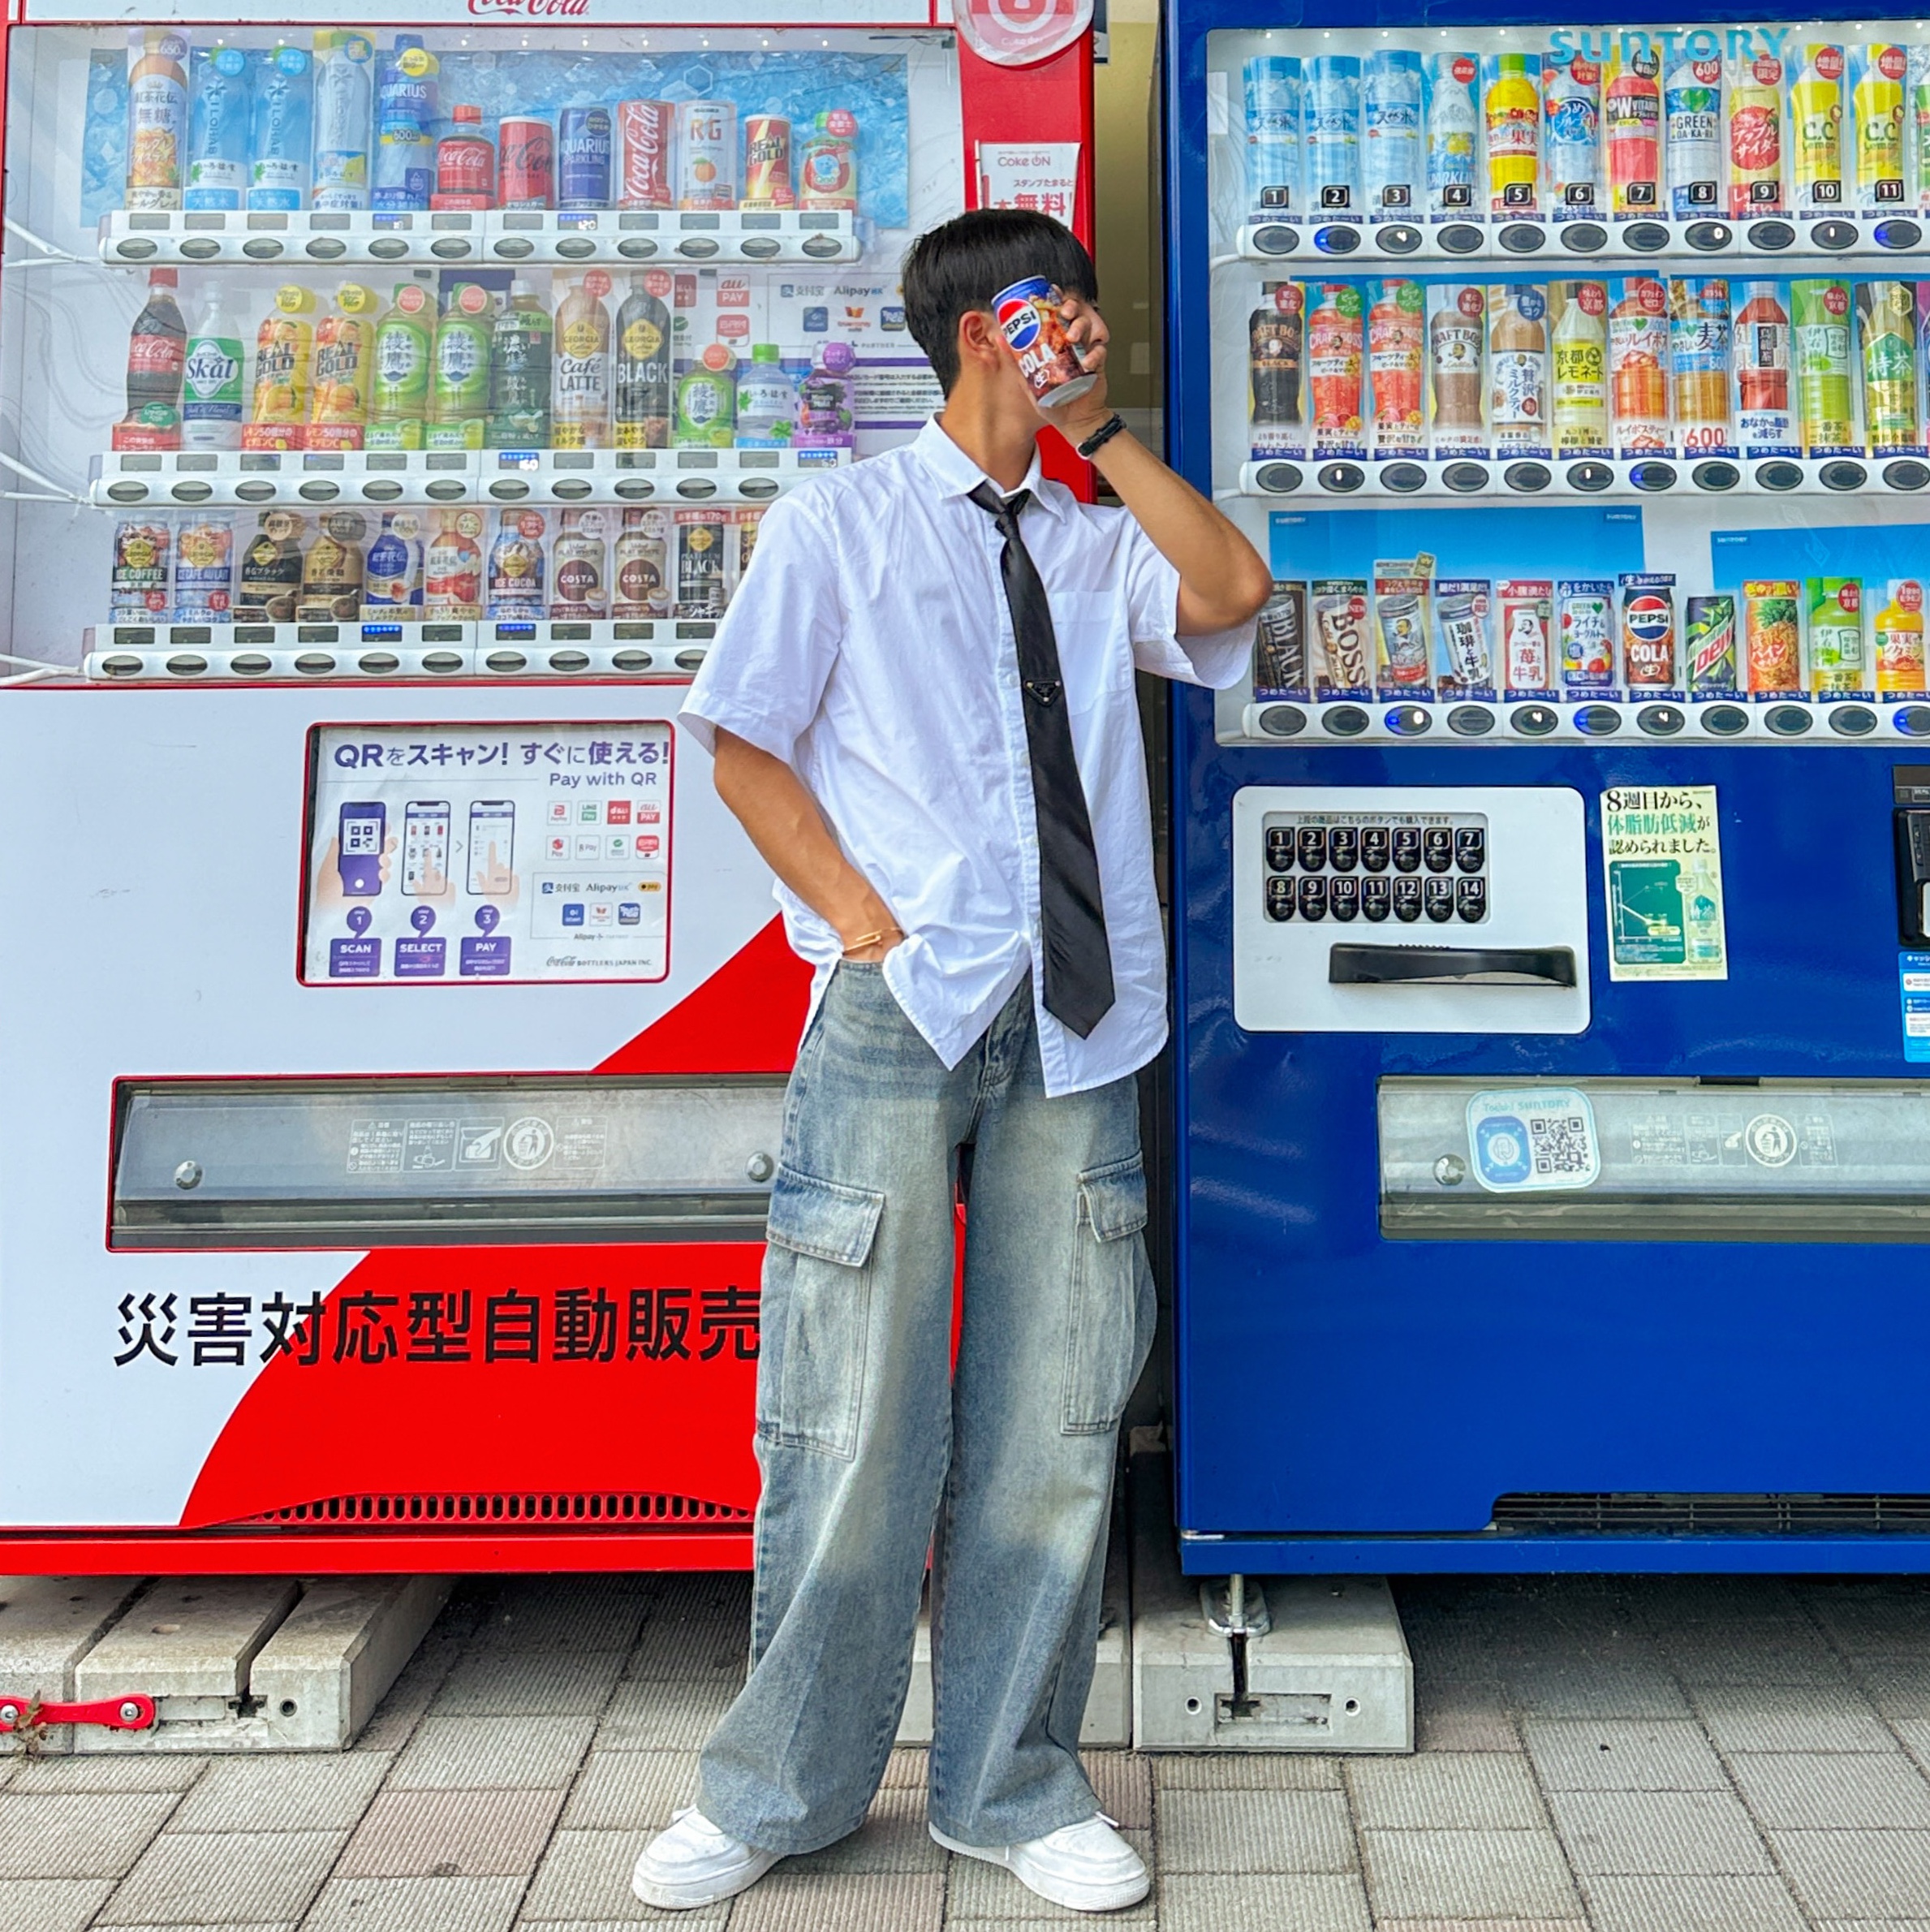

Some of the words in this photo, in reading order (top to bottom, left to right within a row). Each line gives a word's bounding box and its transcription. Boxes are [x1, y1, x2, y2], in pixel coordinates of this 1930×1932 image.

[624, 103, 660, 200] Coca-Cola
[748, 135, 782, 154] REAL
[747, 148, 784, 166] GOLD
[997, 157, 1029, 167] Coke
[1014, 179, 1073, 188] スタンプたまると
[1271, 191, 1277, 201] 1
[1331, 190, 1340, 201] 2
[1392, 189, 1401, 201] 3
[1452, 189, 1461, 201] 4
[1514, 188, 1523, 199] 5
[1575, 188, 1584, 199] 6
[1637, 188, 1645, 198] 7
[1698, 187, 1707, 198] 8
[1760, 186, 1769, 197] 9
[1820, 185, 1834, 197] 10
[1882, 184, 1898, 196] 11
[722, 292, 743, 301] PAY
[1583, 298, 1605, 311] 京都
[257, 340, 295, 361] REAL
[318, 340, 358, 361] REAL
[1557, 349, 1583, 364] 京都
[255, 357, 295, 376] GOLD
[317, 357, 358, 376] GOLD
[560, 357, 601, 375] Café
[1018, 343, 1057, 377] COLA
[1868, 353, 1913, 377] 特茶
[617, 362, 668, 384] BLACK
[559, 376, 601, 391] LATTE
[1521, 368, 1536, 396] 贅沢
[1507, 369, 1521, 419] ミルクティー
[681, 559, 722, 575] BLACK
[508, 578, 536, 588] COCOA
[561, 575, 594, 584] COSTA
[623, 575, 656, 584] COSTA
[1348, 604, 1365, 613] NEW
[1629, 614, 1669, 623] PEPSI
[1332, 614, 1366, 684] BOSS
[1455, 621, 1484, 680] 珈琲と牛乳
[1631, 646, 1669, 662] COLA
[1513, 665, 1543, 682] 牛乳
[521, 741, 670, 765] すぐに使える!
[549, 773, 581, 788] Pay
[586, 771, 625, 786] with
[631, 771, 657, 786] QR
[1606, 790, 1704, 813] 8週目から、
[1607, 813, 1711, 836] 体脂肪低減が
[1276, 832, 1283, 845] 1
[1307, 832, 1316, 845] 2
[1339, 832, 1348, 845] 3
[1369, 832, 1379, 845] 4
[1402, 833, 1411, 845] 5
[1433, 833, 1443, 846] 6
[1464, 833, 1473, 846] 7
[1609, 837, 1717, 855] 認められました。
[1276, 881, 1286, 893] 8
[1307, 882, 1316, 893] 9
[1337, 882, 1352, 894] 10
[1368, 882, 1384, 894] 11
[1399, 882, 1415, 895] 12
[1431, 882, 1447, 895] 13
[1463, 882, 1480, 895] 14
[356, 916, 362, 925] 1
[419, 916, 428, 925] 2
[483, 914, 491, 925] 3
[339, 944, 372, 954] SCAN
[399, 943, 443, 953] SELECT
[475, 942, 497, 952] PAY
[113, 1286, 760, 1369] 災害対応型自動販売
